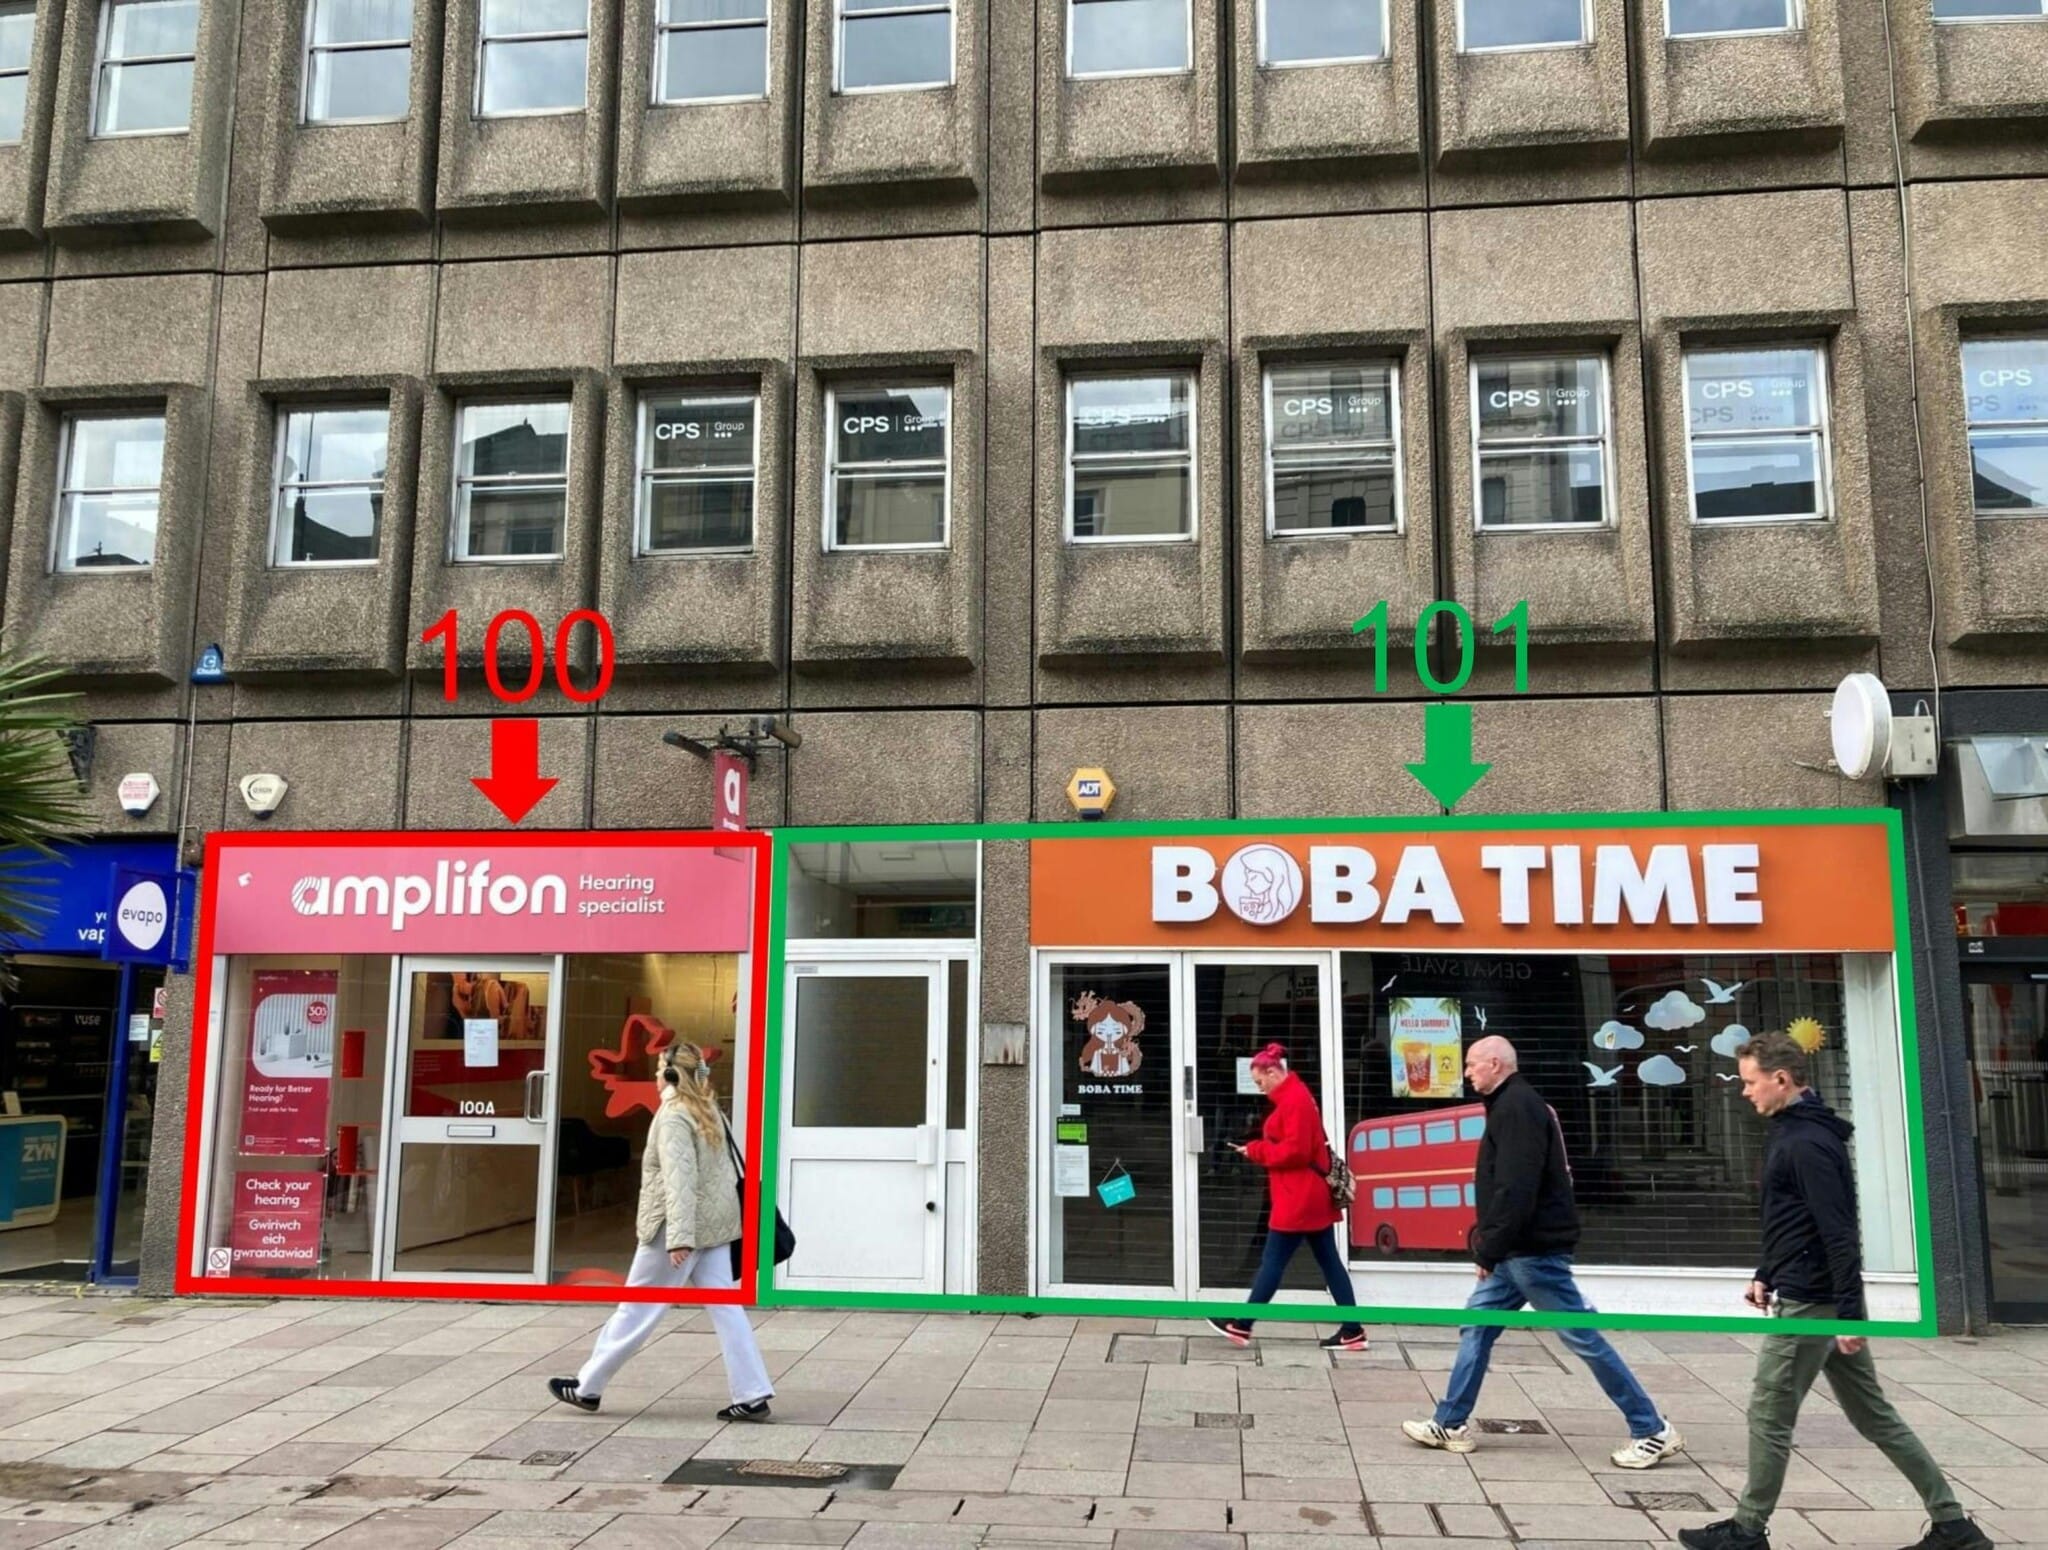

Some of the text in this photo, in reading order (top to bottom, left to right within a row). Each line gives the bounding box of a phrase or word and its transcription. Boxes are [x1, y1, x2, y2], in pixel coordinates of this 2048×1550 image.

[1979, 369, 2033, 387] CPS
[1489, 388, 1591, 408] CPS Group
[1702, 380, 1755, 399] CPS
[1283, 395, 1382, 416] CPS Group
[655, 421, 744, 440] CPS Group
[843, 416, 890, 434] CPS
[1079, 782, 1102, 795] ADT
[579, 874, 655, 895] Hearing
[1481, 843, 1765, 926] TIME
[291, 858, 567, 931] amplifon
[578, 897, 665, 917] specialist
[121, 908, 164, 926] evapo
[250, 1084, 313, 1096] Ready for Better
[1078, 1084, 1143, 1094] BOBA TIME
[249, 1093, 284, 1104] Hearing?
[459, 1100, 496, 1116] 100A
[22, 1141, 57, 1163] ZYN
[245, 1178, 312, 1194] Check your
[255, 1193, 301, 1208] hearing
[248, 1219, 301, 1231] Gwiriwch
[262, 1234, 286, 1245] eich
[233, 1247, 313, 1261] gwrandawiad
